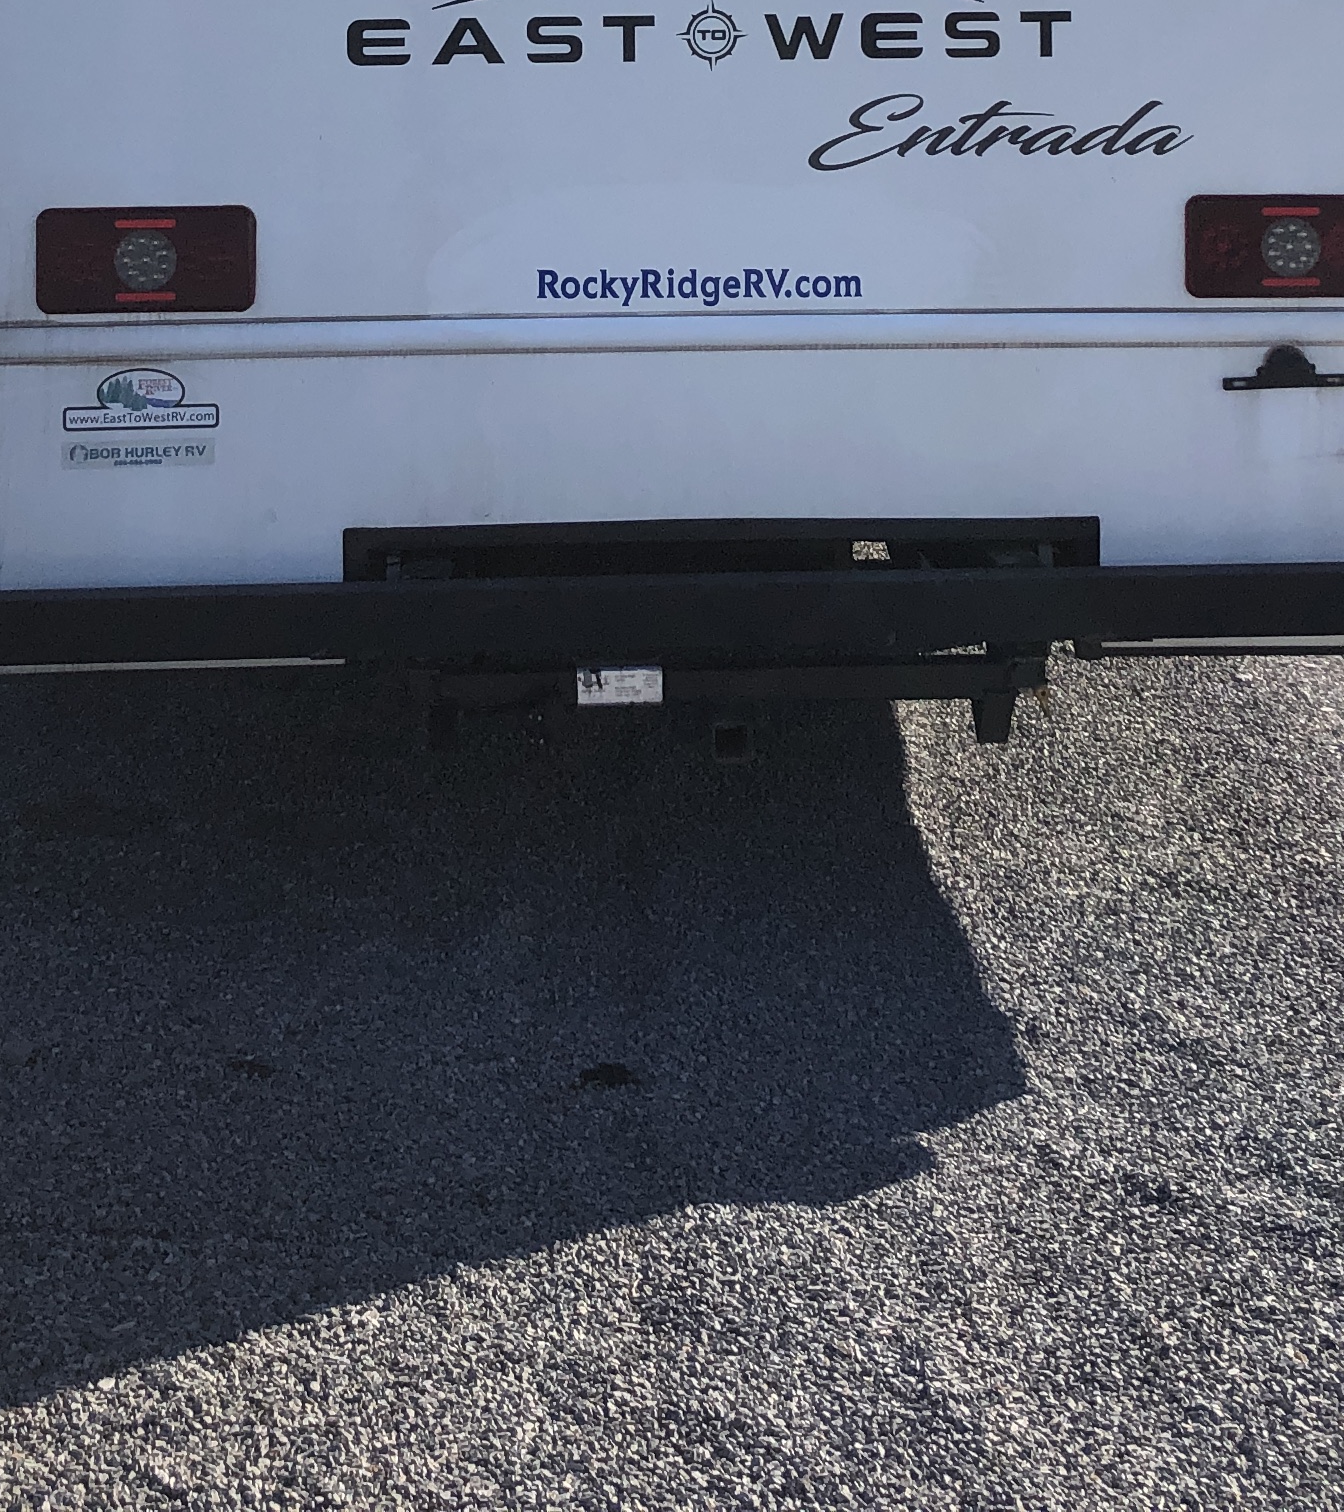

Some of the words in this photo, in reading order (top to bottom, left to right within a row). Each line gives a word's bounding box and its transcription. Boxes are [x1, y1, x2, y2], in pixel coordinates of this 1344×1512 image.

[346, 15, 656, 67] EAST
[696, 29, 727, 41] TO
[764, 10, 1073, 61] WEST
[807, 93, 1195, 171] Entrada
[536, 267, 863, 307] RockyRidgeRV.com
[69, 411, 215, 425] www.EastToWestRV.com
[124, 446, 182, 459] HURLEY
[185, 445, 207, 457] RV
